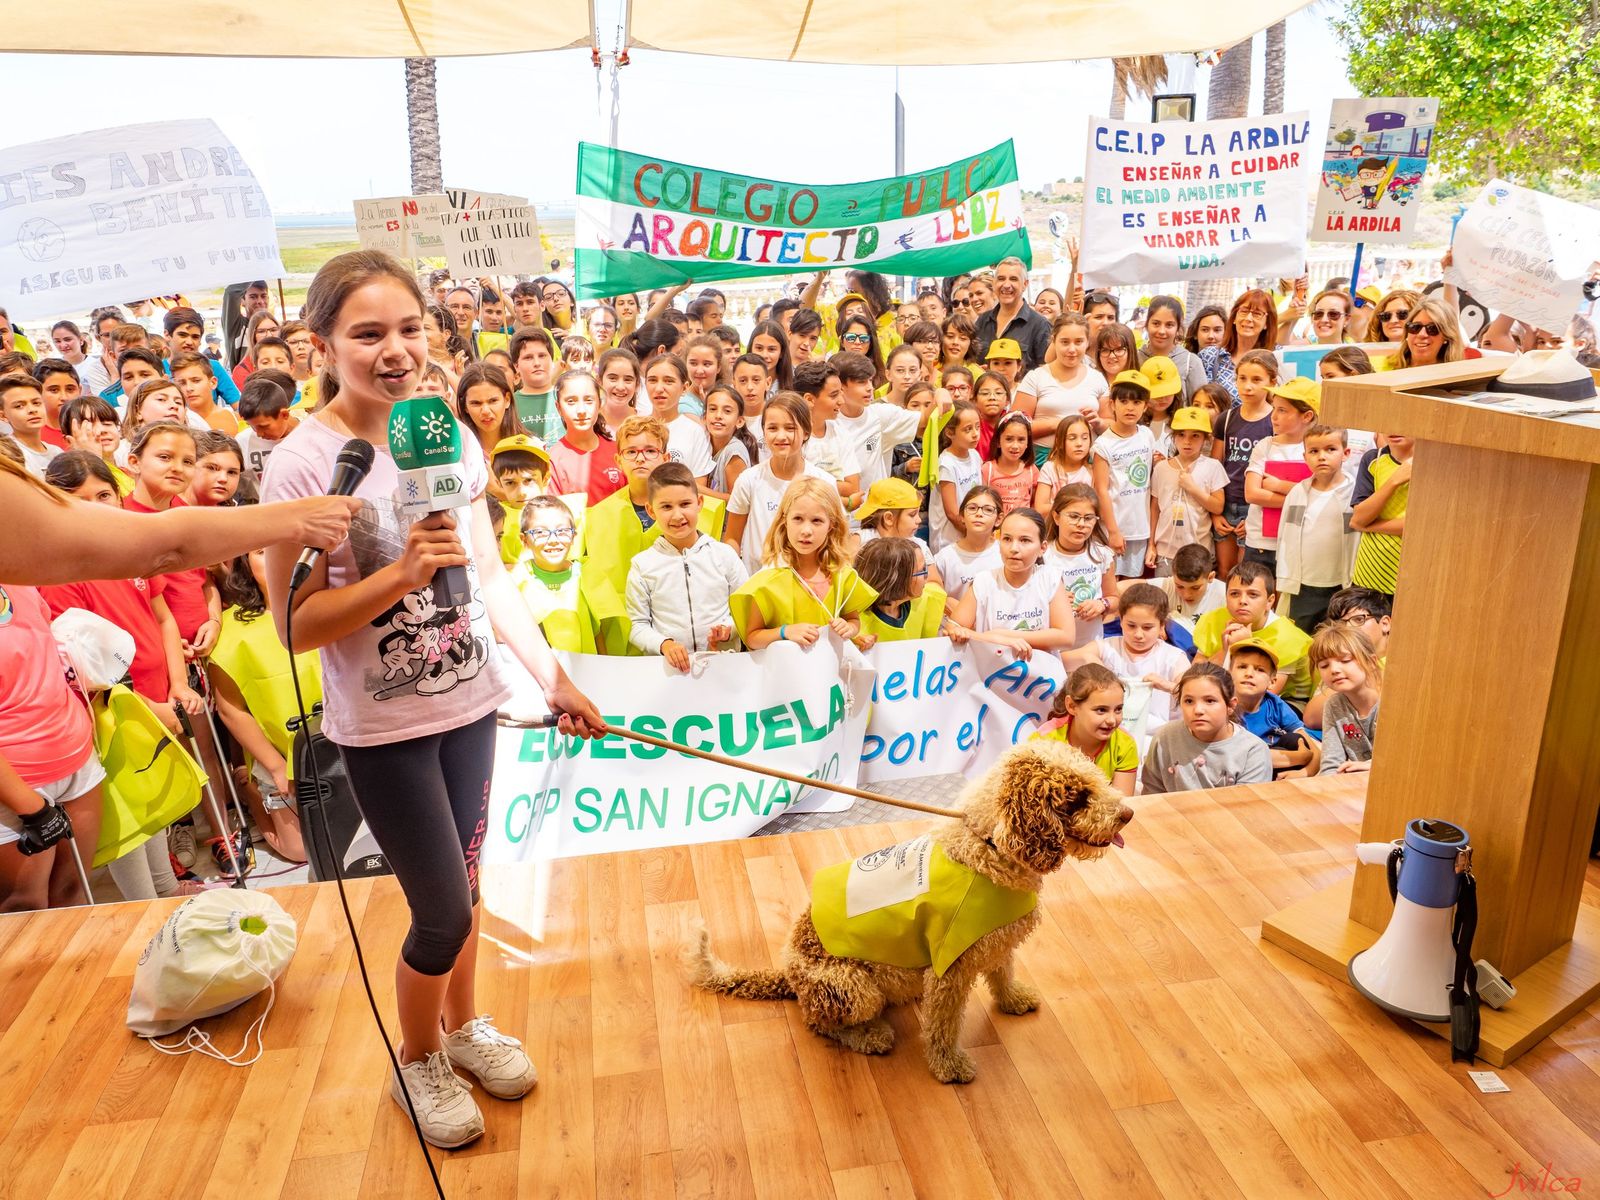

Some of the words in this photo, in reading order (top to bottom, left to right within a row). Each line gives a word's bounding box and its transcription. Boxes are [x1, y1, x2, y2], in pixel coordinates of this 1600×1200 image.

[1185, 133, 1216, 156] LA
[109, 145, 255, 190] ANDRE
[1122, 162, 1202, 182] ENSEÑAR
[1208, 163, 1220, 179] A
[1231, 151, 1300, 176] CUIDAR
[633, 162, 819, 227] COLEGIO
[1096, 187, 1113, 205] EL
[1121, 187, 1171, 205] MEDIO
[1177, 180, 1266, 202] AMBIENTE
[401, 199, 419, 217] NO
[1122, 213, 1145, 228] ES
[1158, 205, 1240, 227] ENSEÑAR
[1254, 204, 1267, 223] A
[623, 212, 880, 265] ARQUITECTO
[934, 190, 1006, 244] LEOZ
[1326, 215, 1344, 231] LA
[1347, 216, 1401, 232] ARDILA
[1144, 229, 1219, 248] VALORAR
[1230, 227, 1251, 243] LA
[19, 263, 128, 296] ASEGURA
[151, 254, 187, 273] TU
[436, 477, 456, 493] AD
[572, 783, 669, 834] SAN
